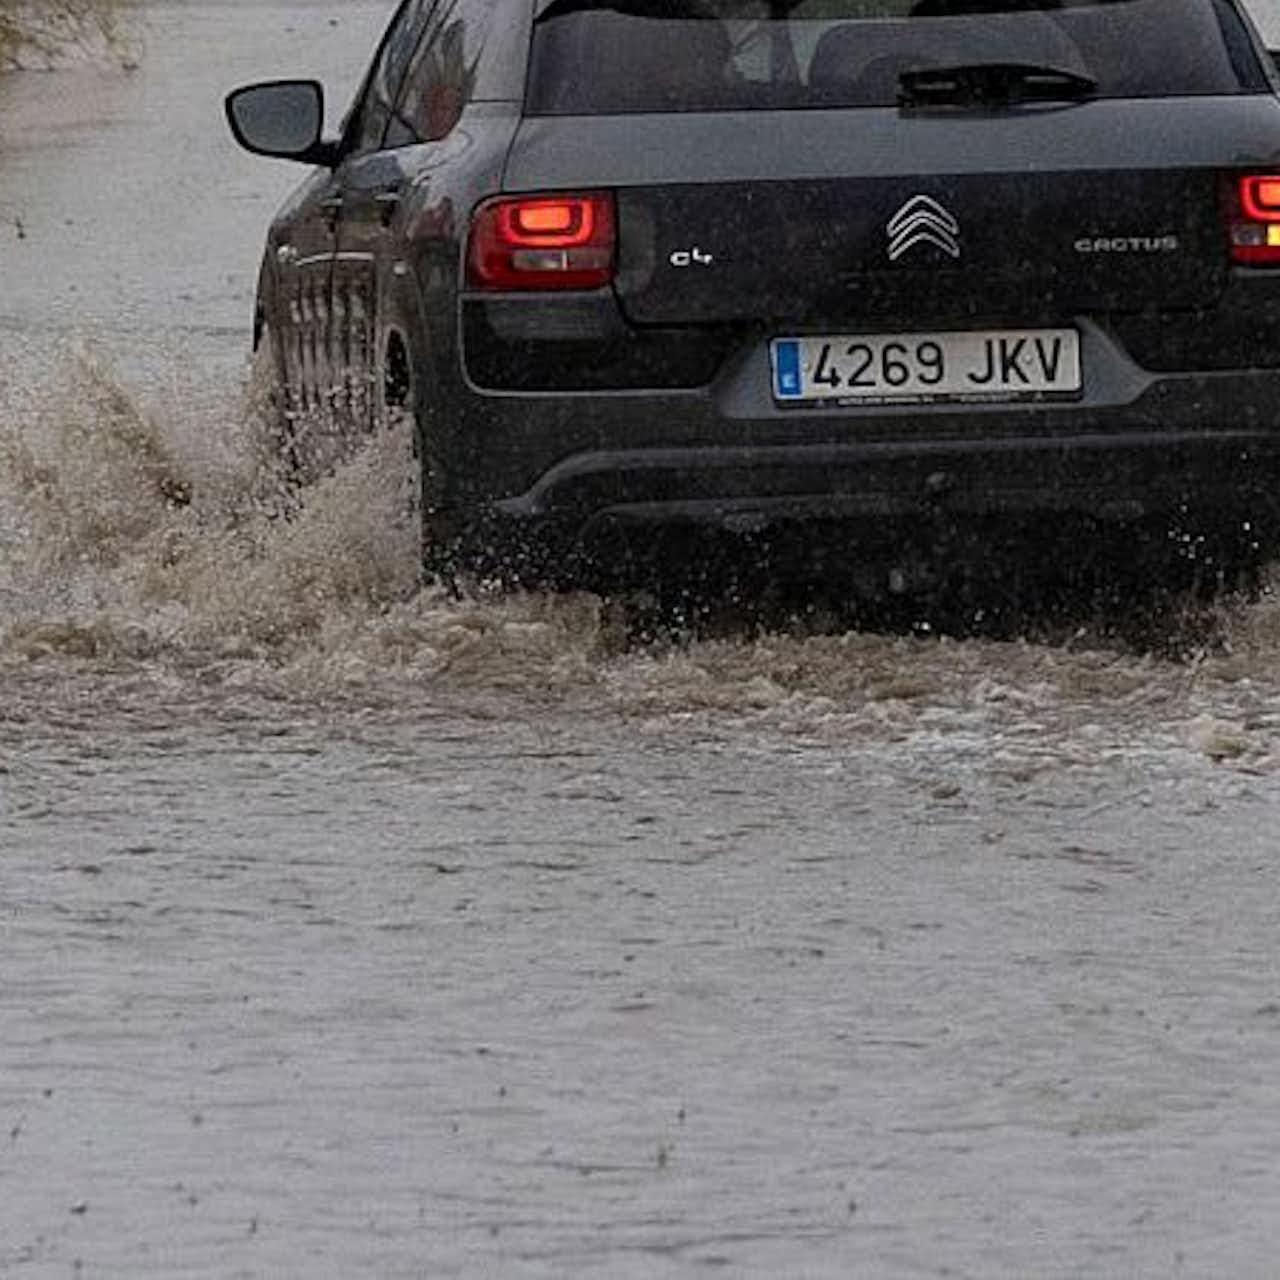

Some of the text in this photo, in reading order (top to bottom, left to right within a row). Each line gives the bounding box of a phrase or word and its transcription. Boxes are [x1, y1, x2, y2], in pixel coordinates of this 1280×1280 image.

[1073, 235, 1177, 252] CACTUS
[812, 340, 945, 388] 4269
[967, 337, 1062, 385] JKV
